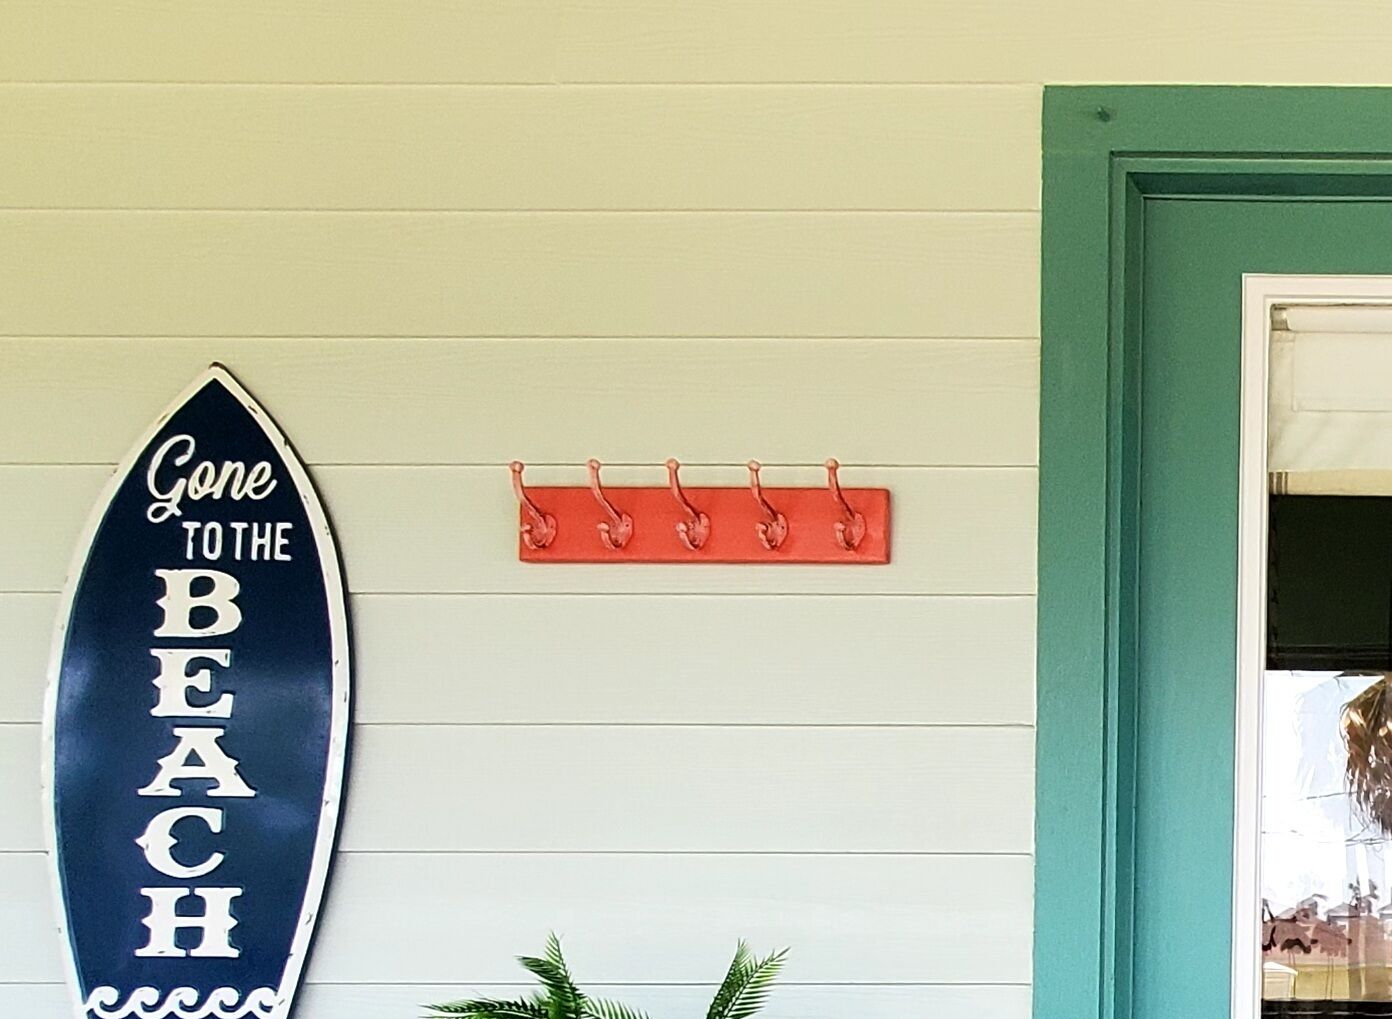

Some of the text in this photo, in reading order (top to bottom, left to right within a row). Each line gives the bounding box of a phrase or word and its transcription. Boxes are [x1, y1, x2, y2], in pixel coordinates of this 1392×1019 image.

[147, 434, 277, 523] Gone
[183, 521, 293, 561] TO THE
[134, 567, 256, 958] BEACH
